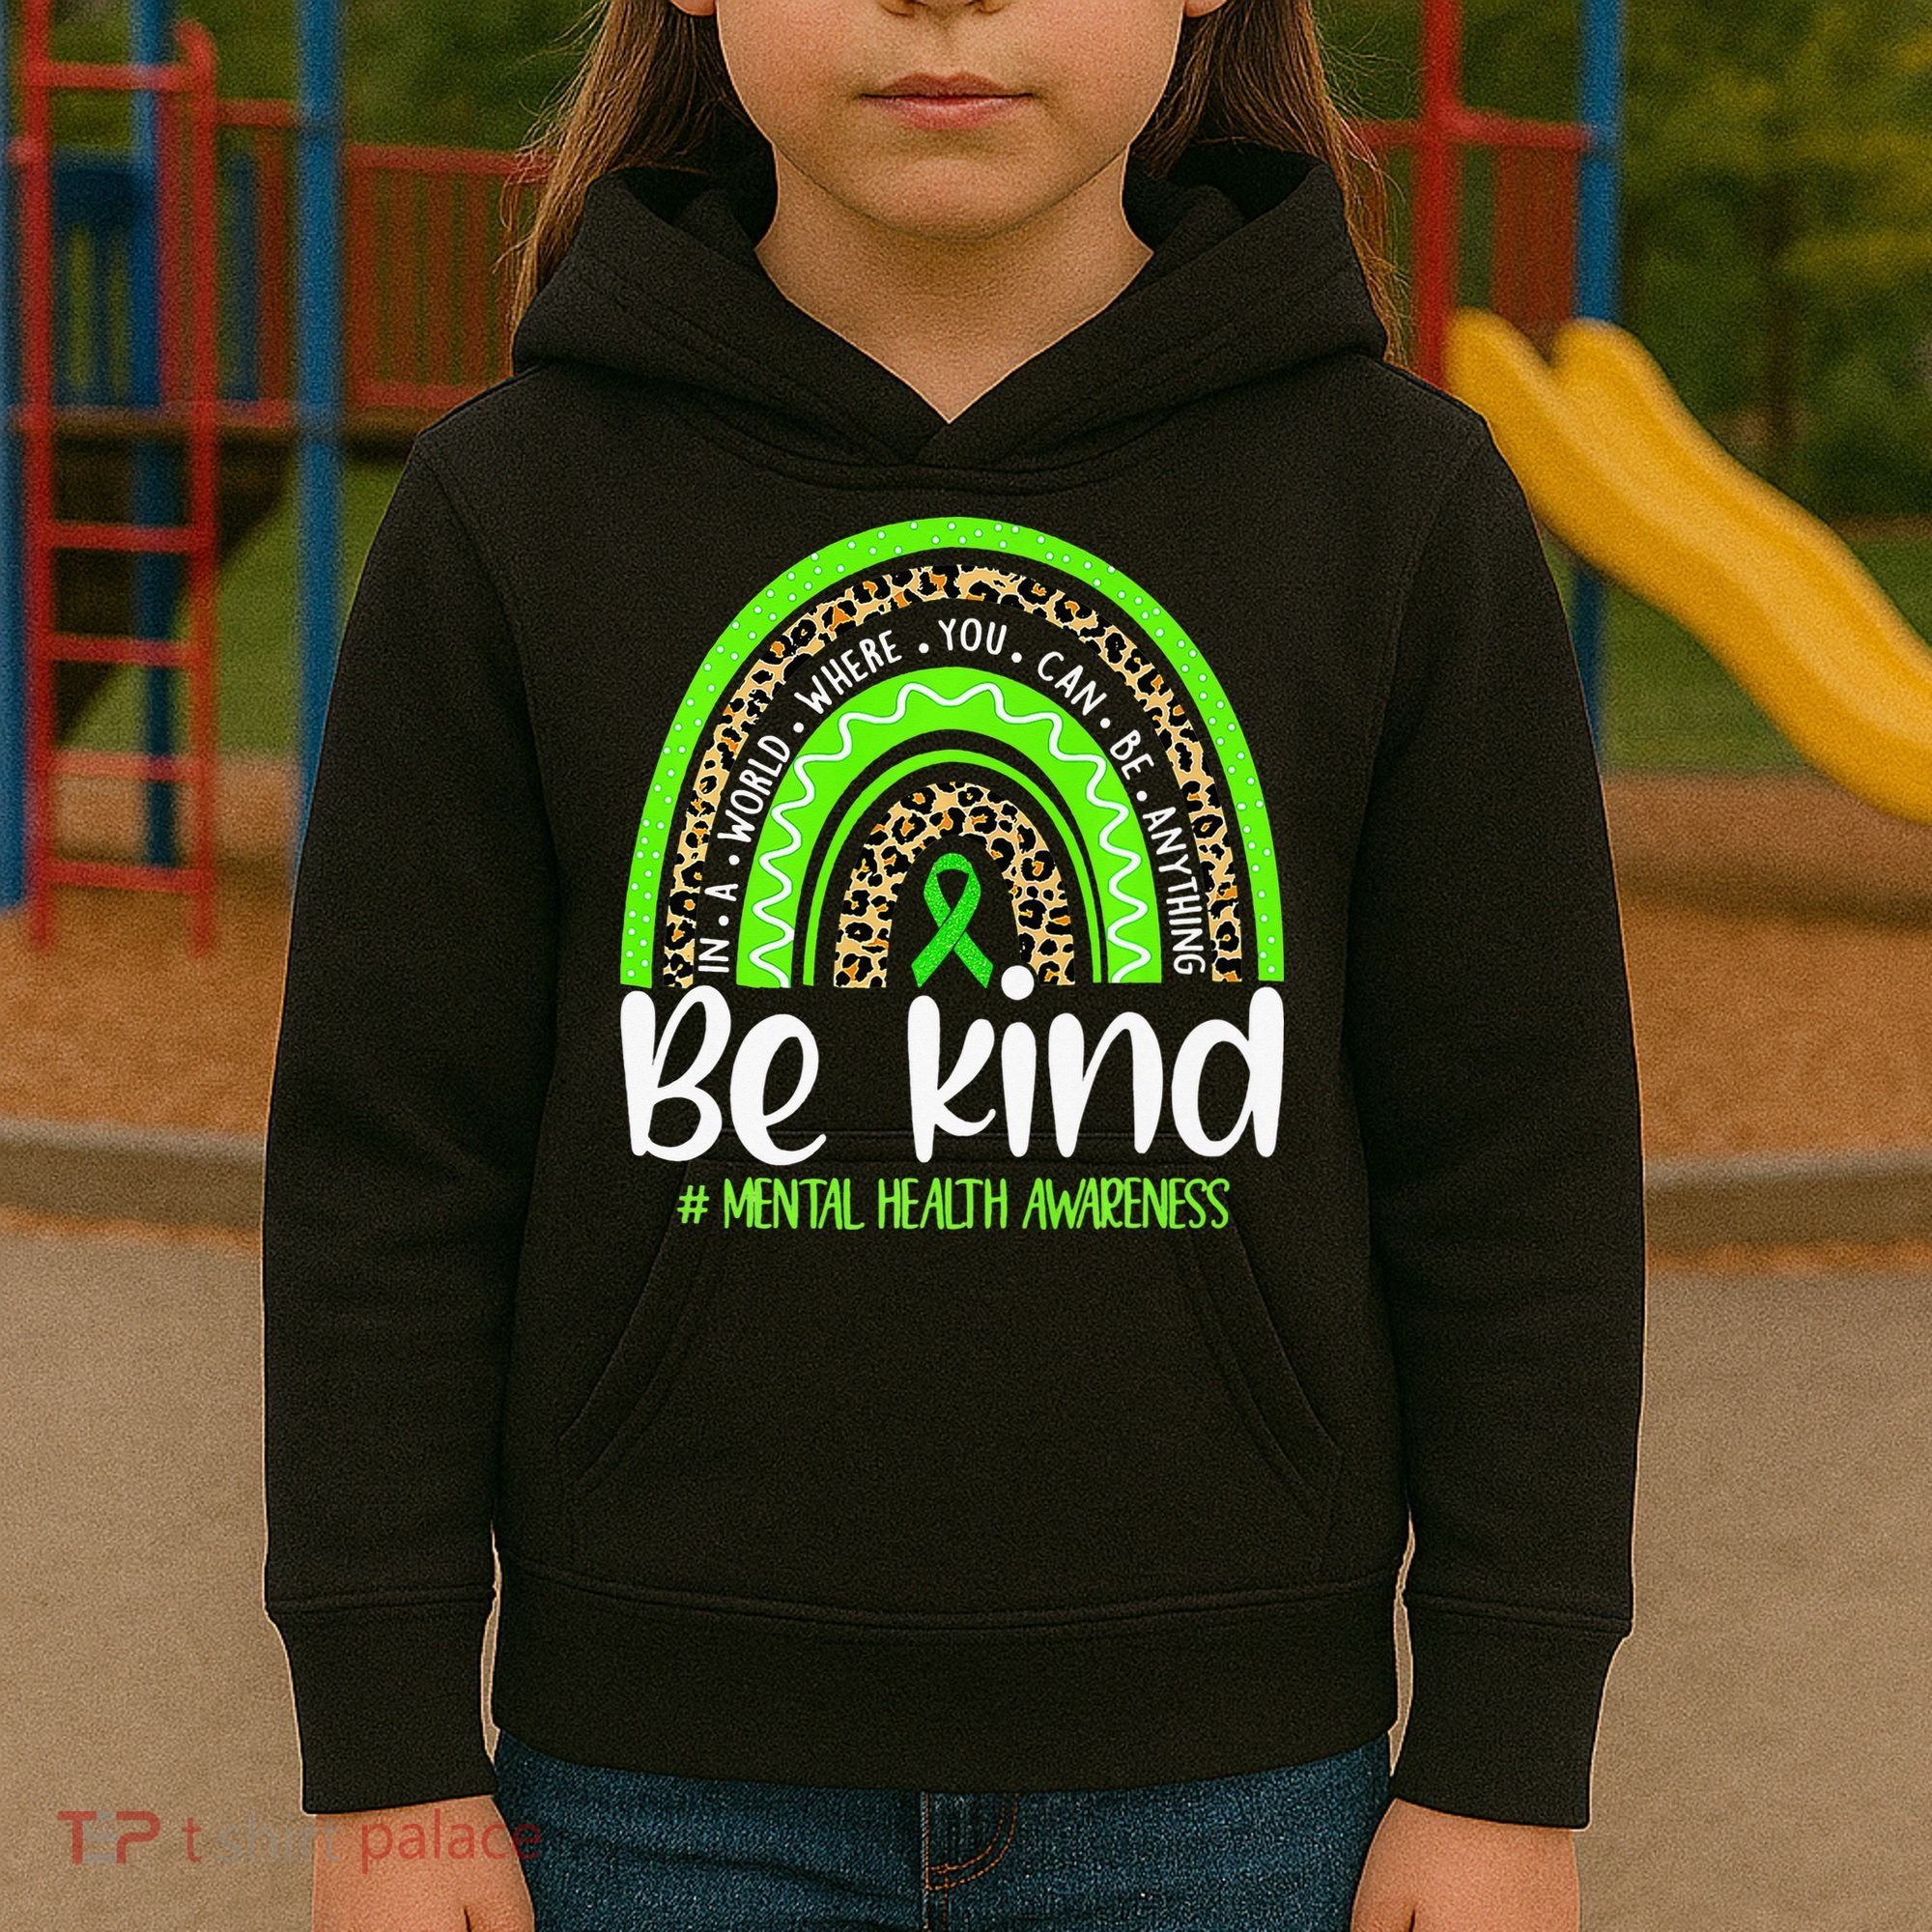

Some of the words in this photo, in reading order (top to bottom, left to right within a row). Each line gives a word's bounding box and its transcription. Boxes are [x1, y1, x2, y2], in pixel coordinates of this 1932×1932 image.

[937, 617, 1008, 656] YOU
[793, 629, 903, 715] WHERE
[1037, 651, 1108, 717] CAN
[1109, 728, 1155, 781] BE
[717, 735, 790, 843] WORLD
[703, 883, 739, 902] A
[1142, 806, 1207, 976] ANYTHING
[697, 937, 730, 974] IN
[619, 984, 827, 1166] Be
[907, 965, 1285, 1163] kind
[724, 1176, 866, 1231] MENTAL
[877, 1177, 1009, 1231] HEALTH
[1021, 1177, 1231, 1231] AWARENESS
